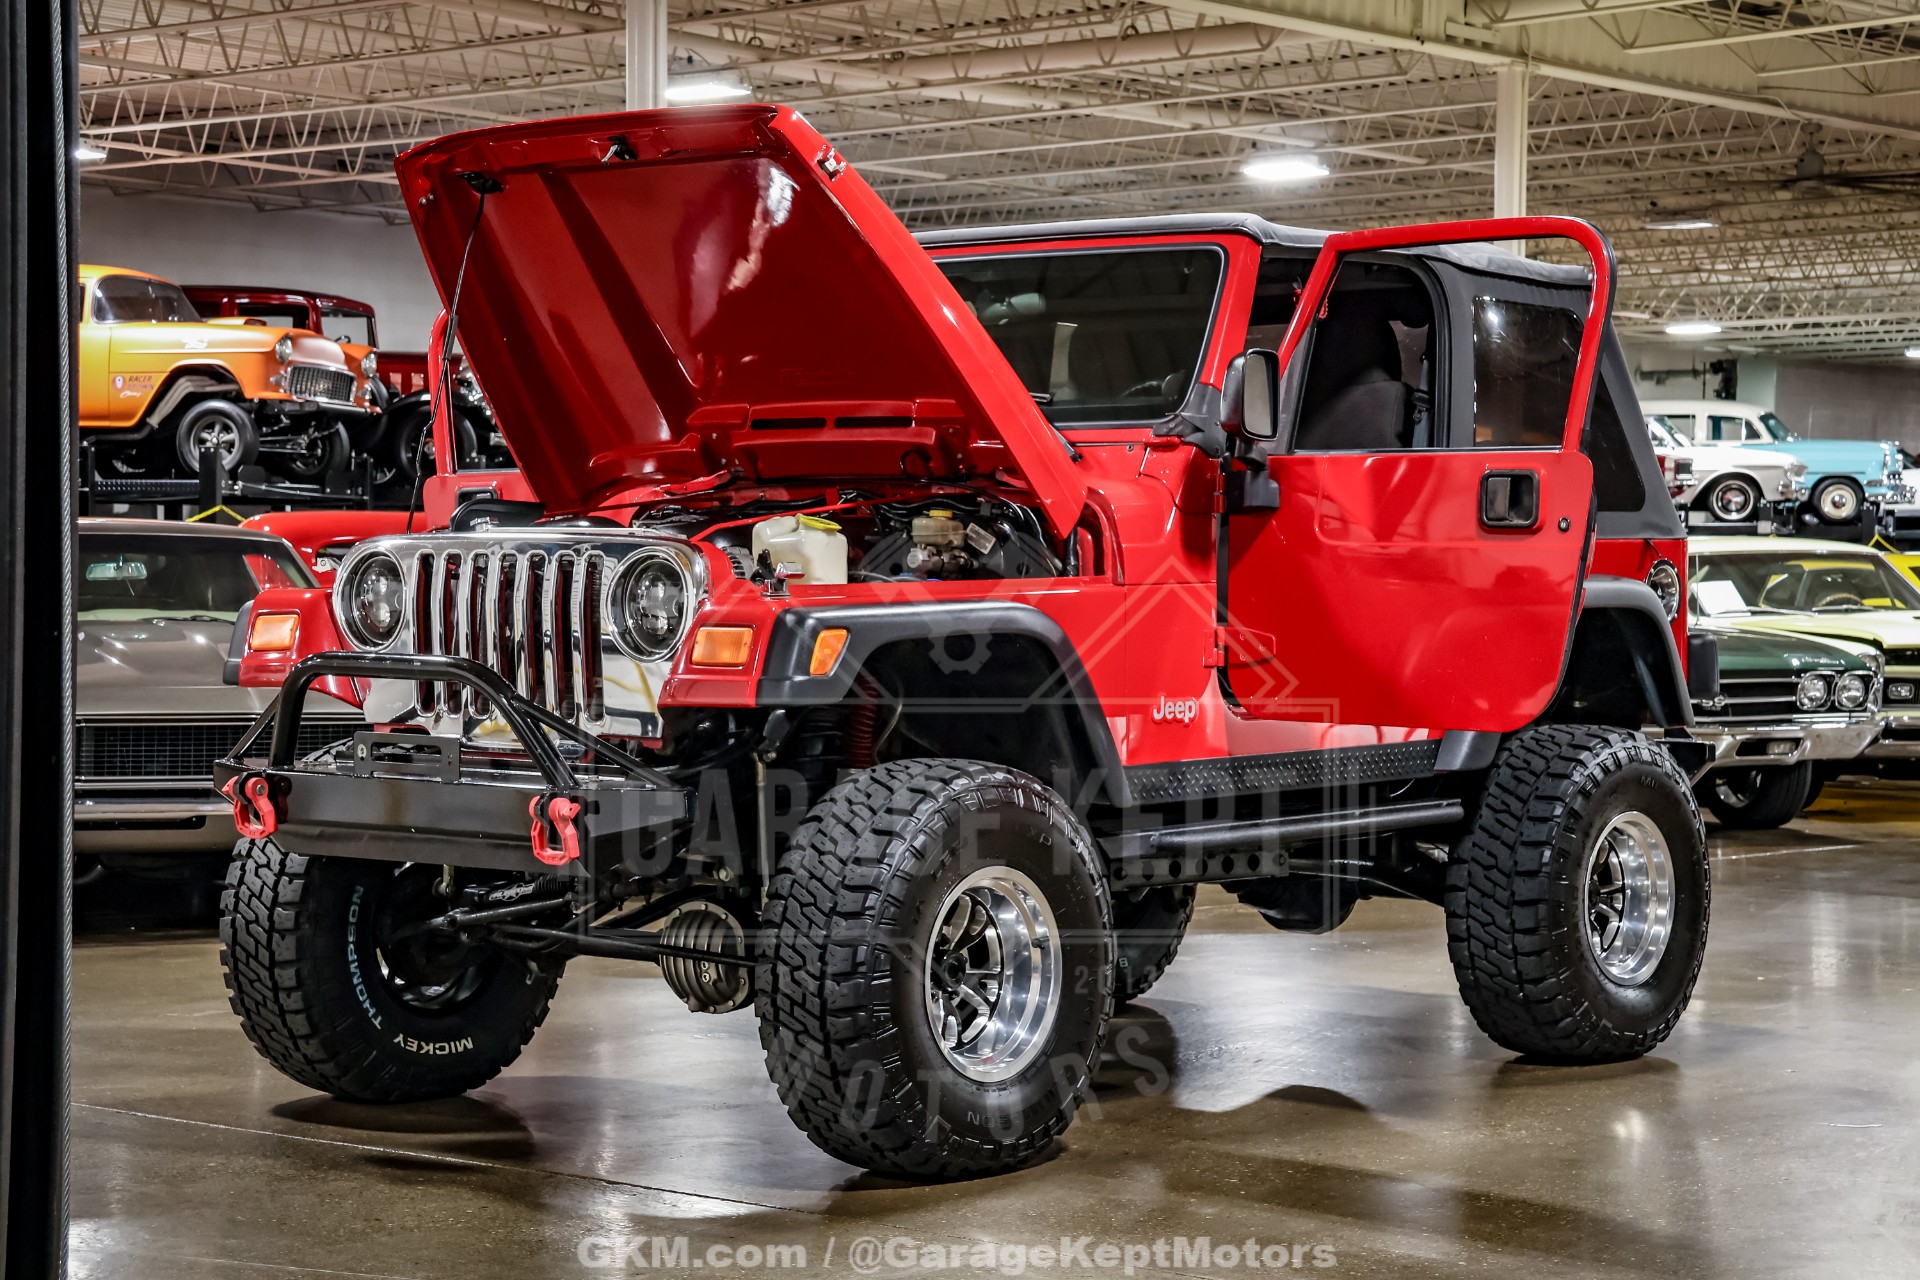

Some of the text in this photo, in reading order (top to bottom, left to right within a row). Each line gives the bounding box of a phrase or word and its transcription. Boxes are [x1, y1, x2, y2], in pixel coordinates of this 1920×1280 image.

[1153, 695, 1196, 723] Jeep
[347, 885, 474, 1055] MICKEY THOMPSON
